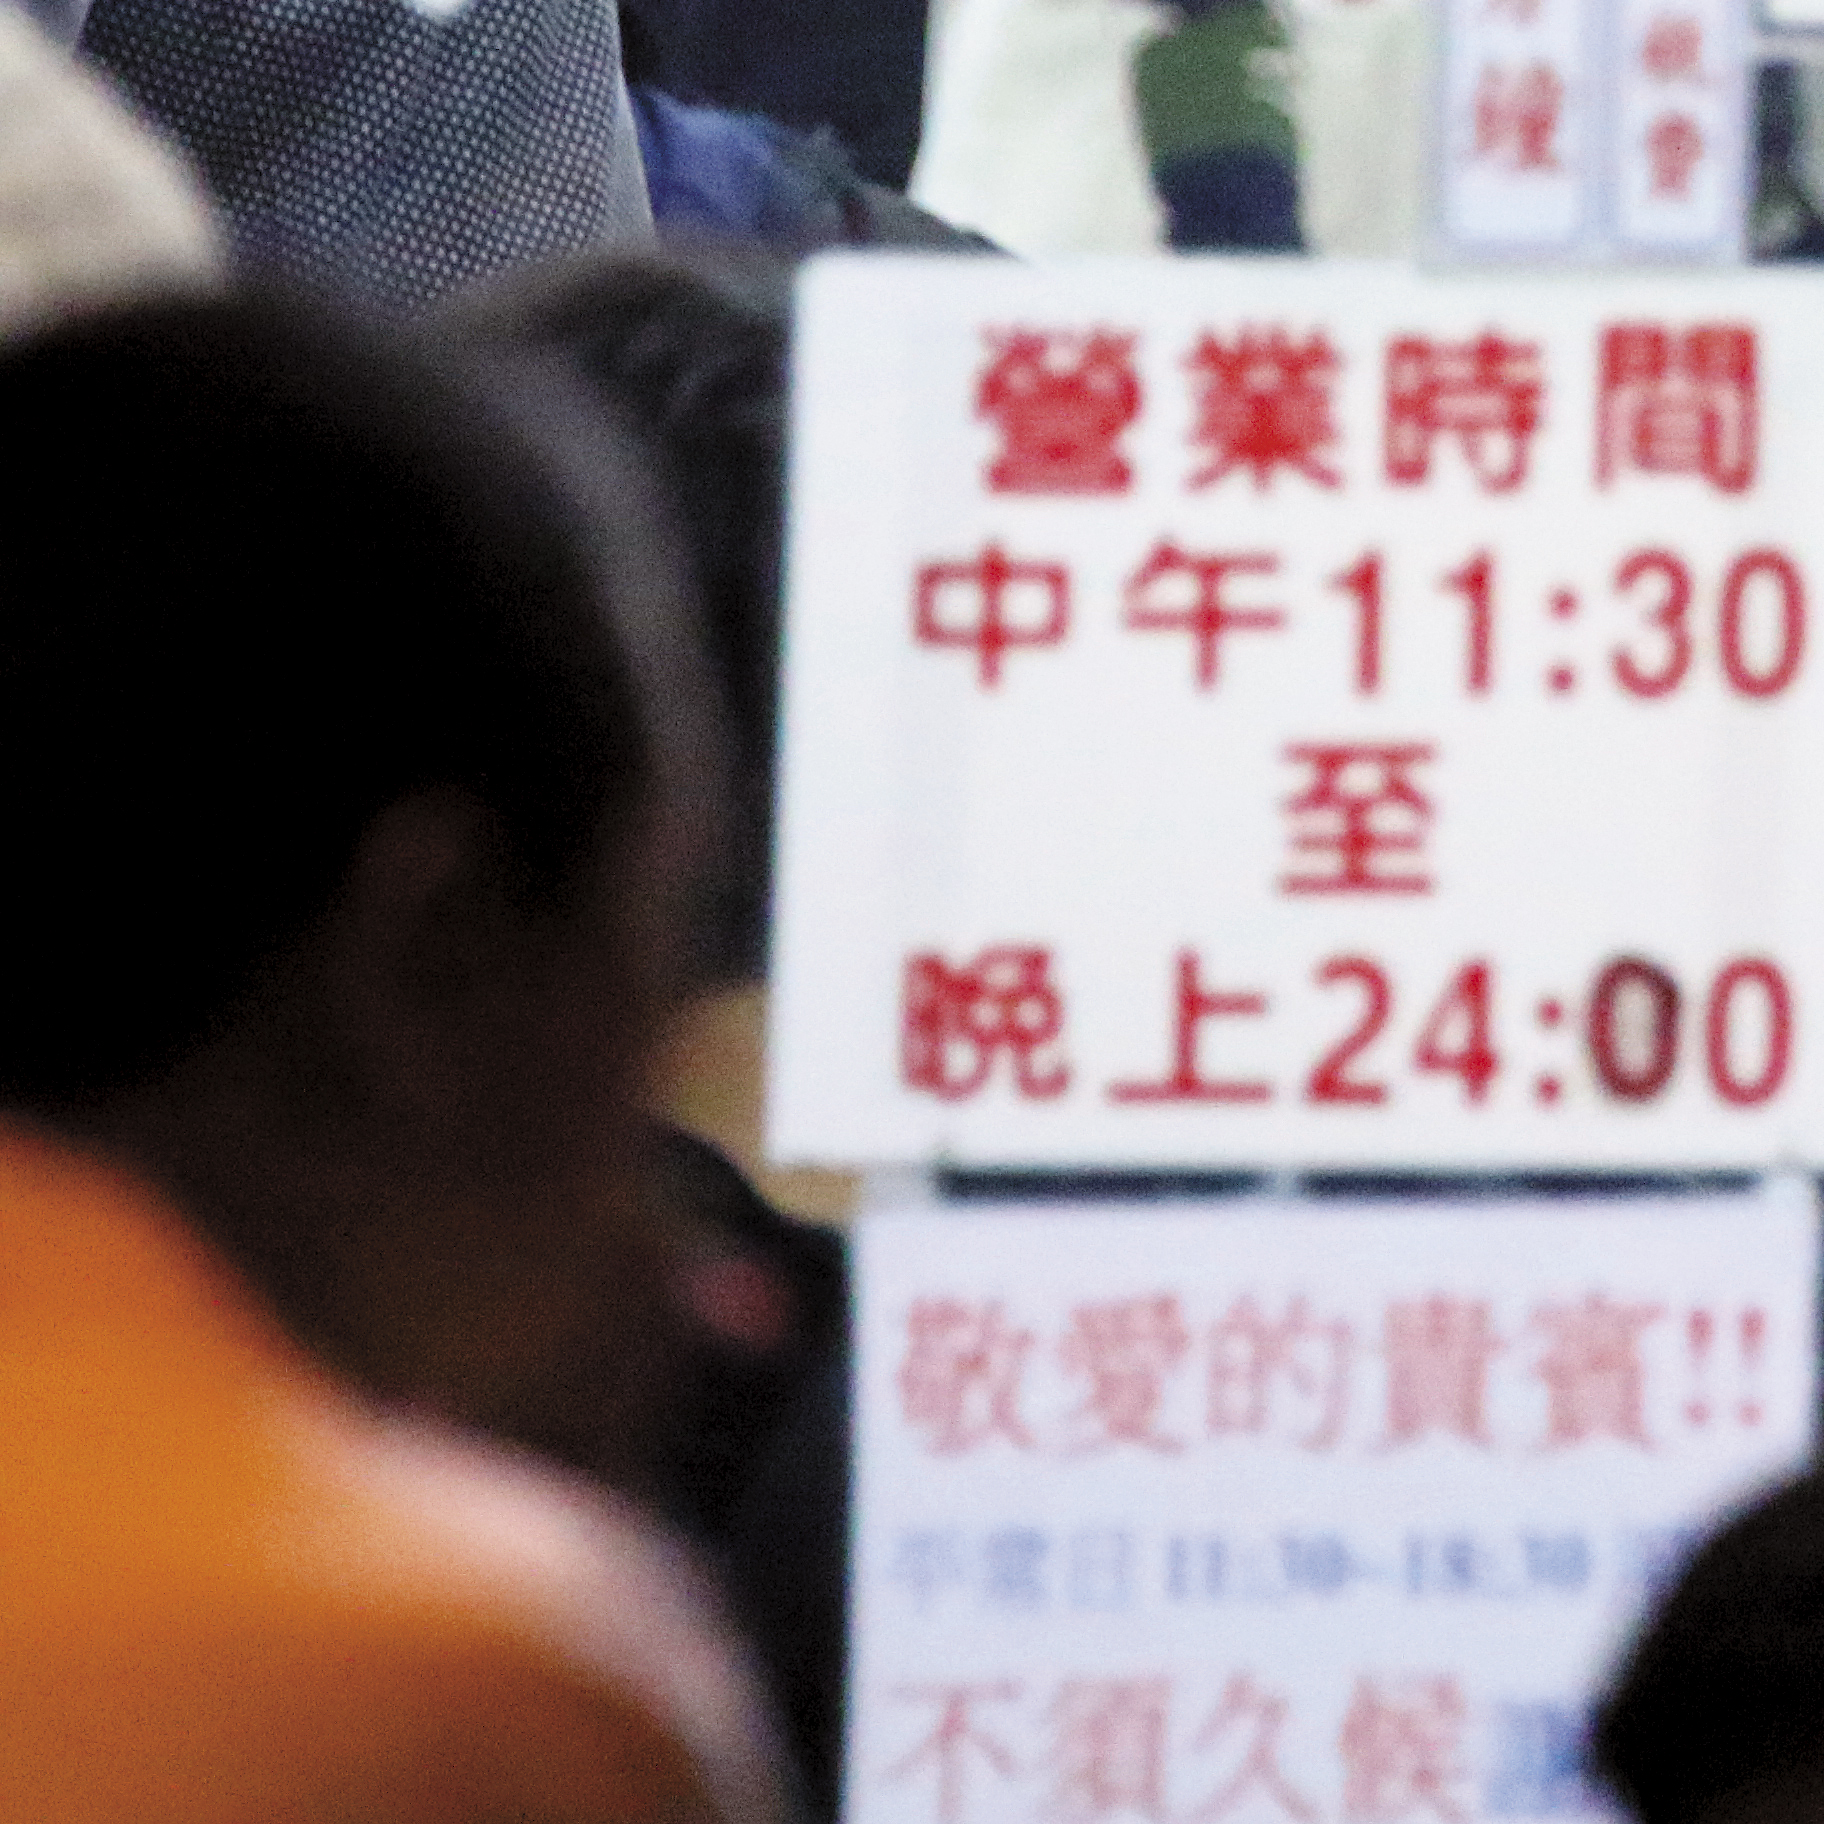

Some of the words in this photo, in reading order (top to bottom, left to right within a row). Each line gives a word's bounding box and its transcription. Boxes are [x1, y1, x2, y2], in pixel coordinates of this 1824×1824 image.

[970, 318, 1766, 499] 營業時間
[908, 538, 1811, 700] 中午11:30
[1272, 740, 1440, 900] 至
[896, 939, 1799, 1110] 晚上24:00
[894, 1290, 1769, 1458] 敬愛的貴賓!!
